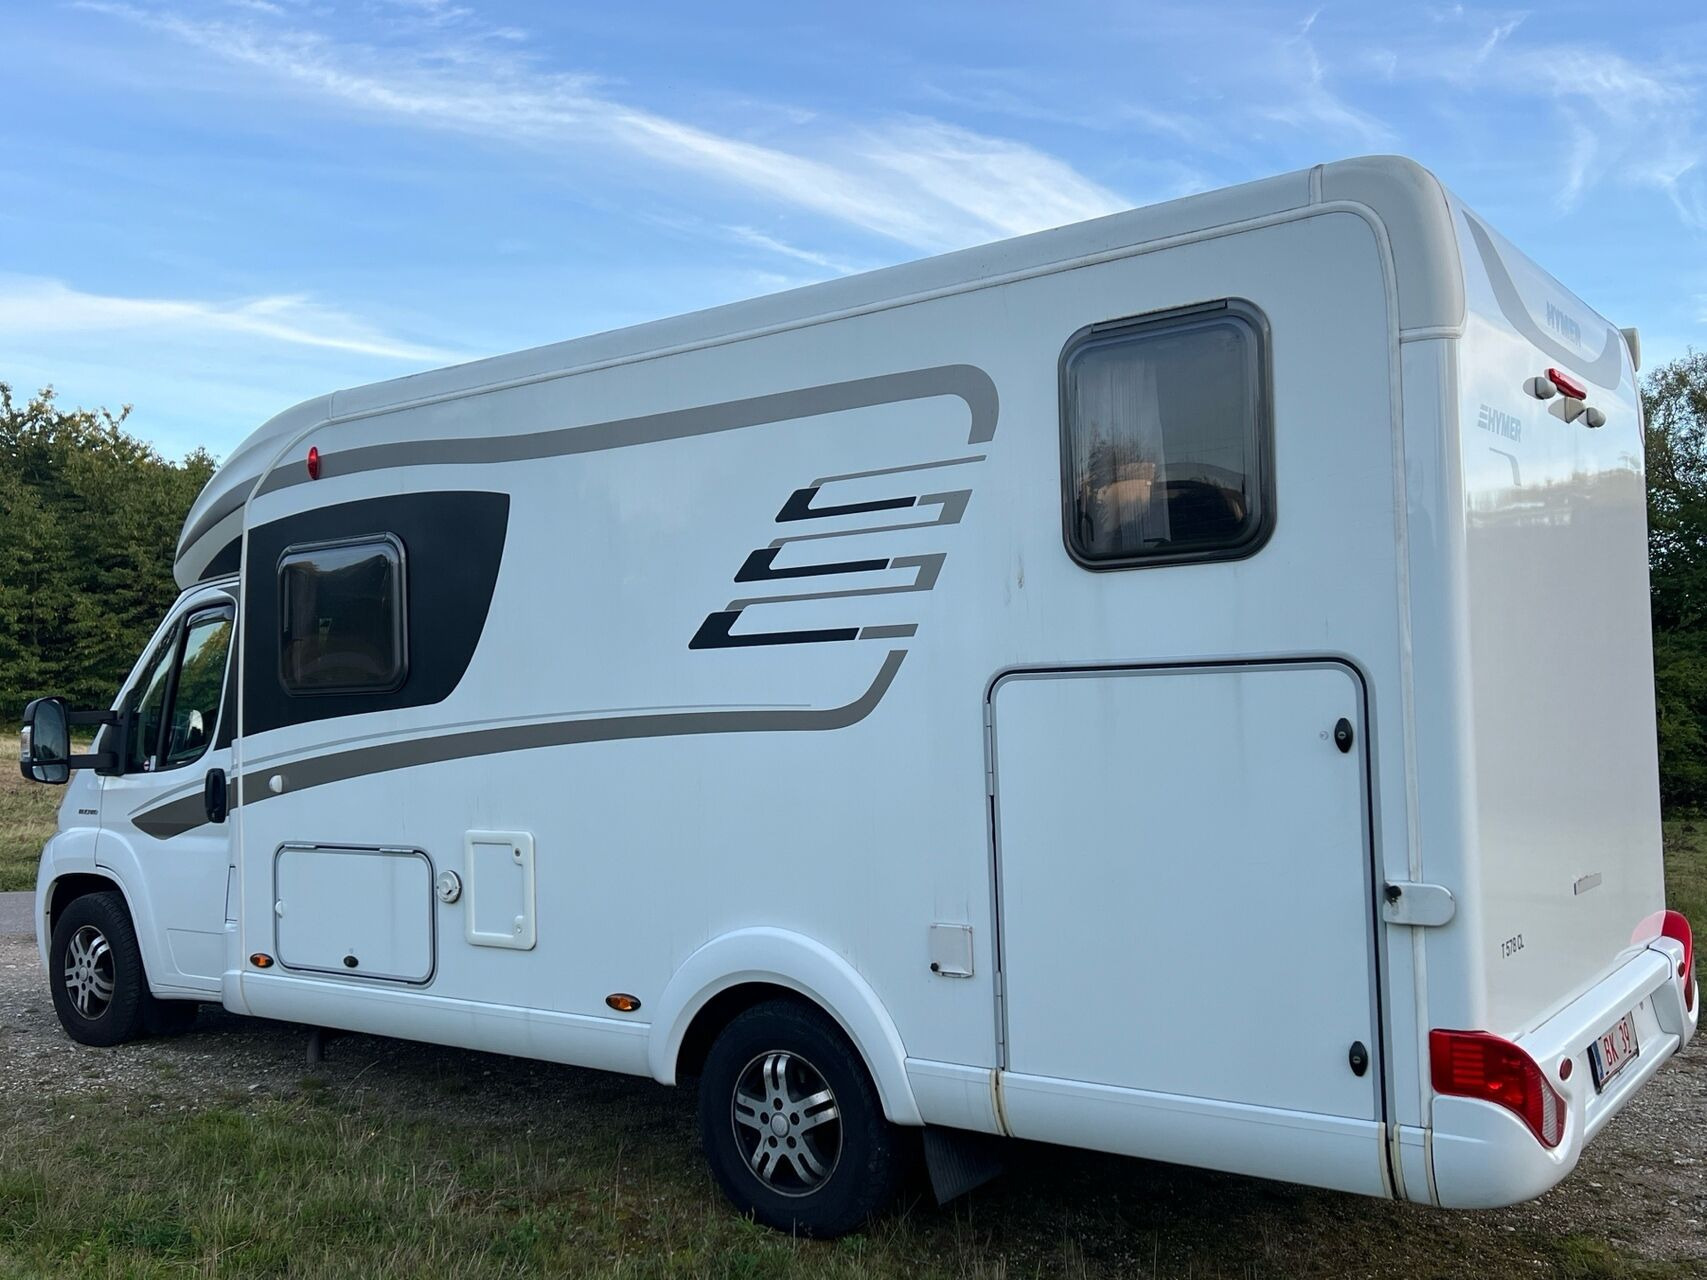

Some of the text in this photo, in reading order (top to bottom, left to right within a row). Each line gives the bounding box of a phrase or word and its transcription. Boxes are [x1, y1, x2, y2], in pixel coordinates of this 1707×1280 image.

[1546, 301, 1582, 348] HYMER
[1488, 407, 1521, 442] HYMER
[1501, 943, 1505, 959] T
[1506, 937, 1517, 957] 578
[1603, 1032, 1620, 1066] BK
